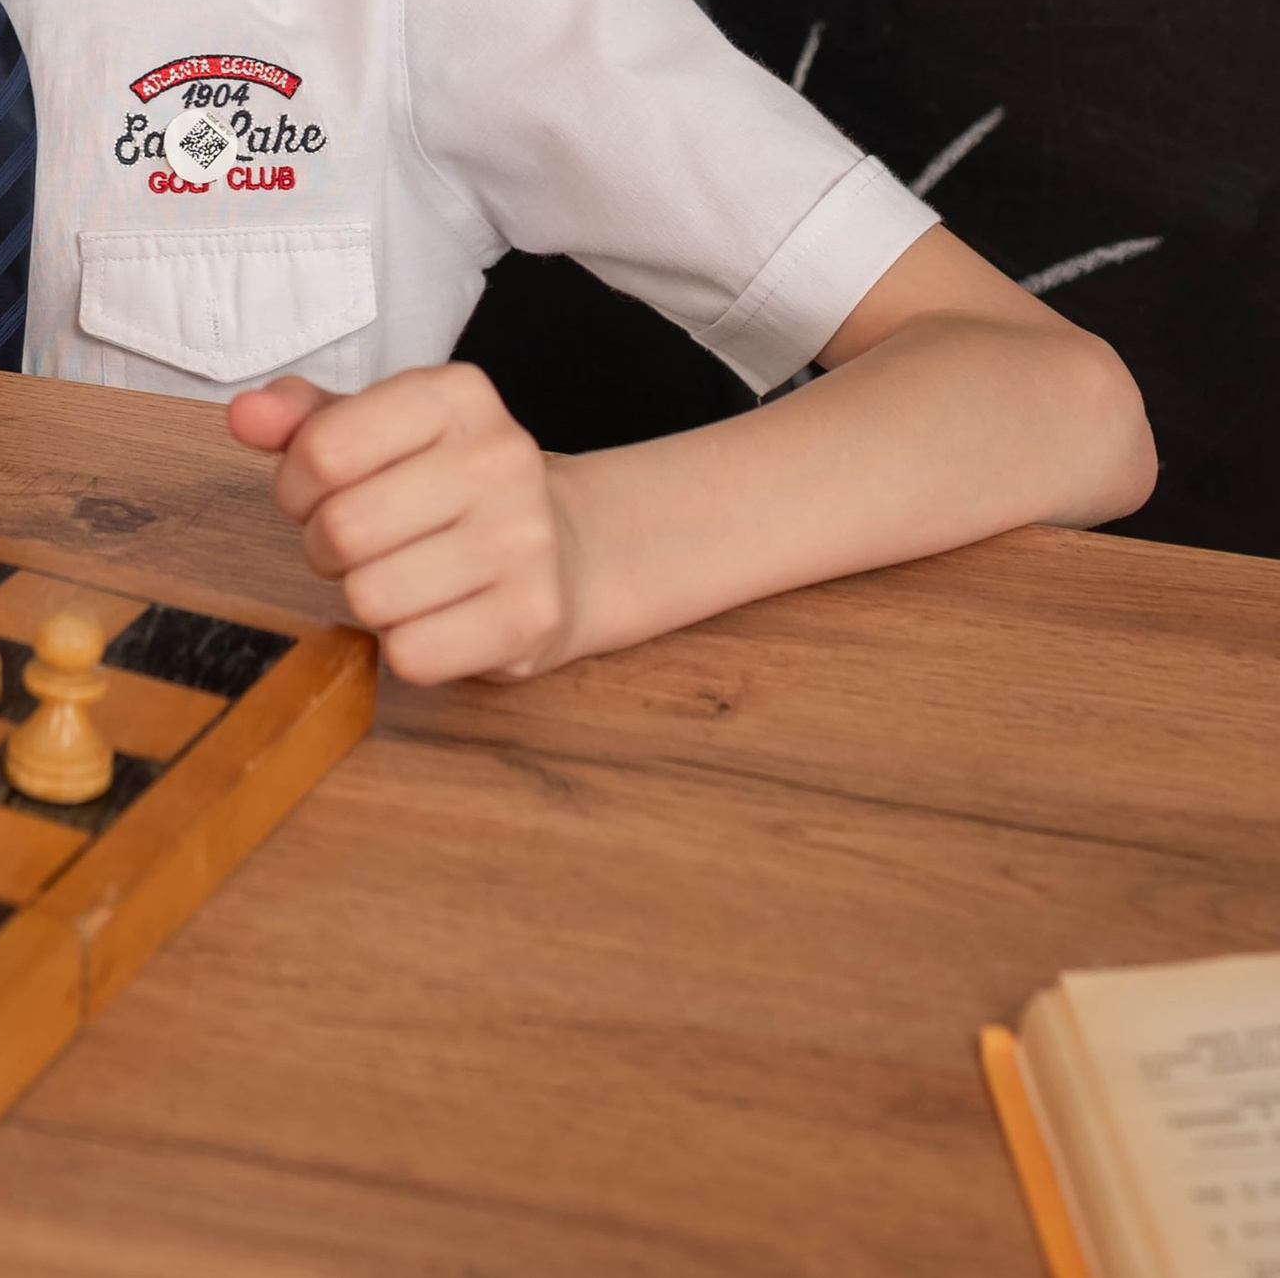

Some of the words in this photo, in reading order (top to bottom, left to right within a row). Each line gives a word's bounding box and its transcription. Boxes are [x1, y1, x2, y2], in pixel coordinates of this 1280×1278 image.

[142, 57, 211, 97] ATLANTA
[219, 56, 289, 89] GEORGIA
[181, 81, 250, 109] 1904
[115, 112, 168, 166] Ea
[226, 165, 296, 191] CLUB
